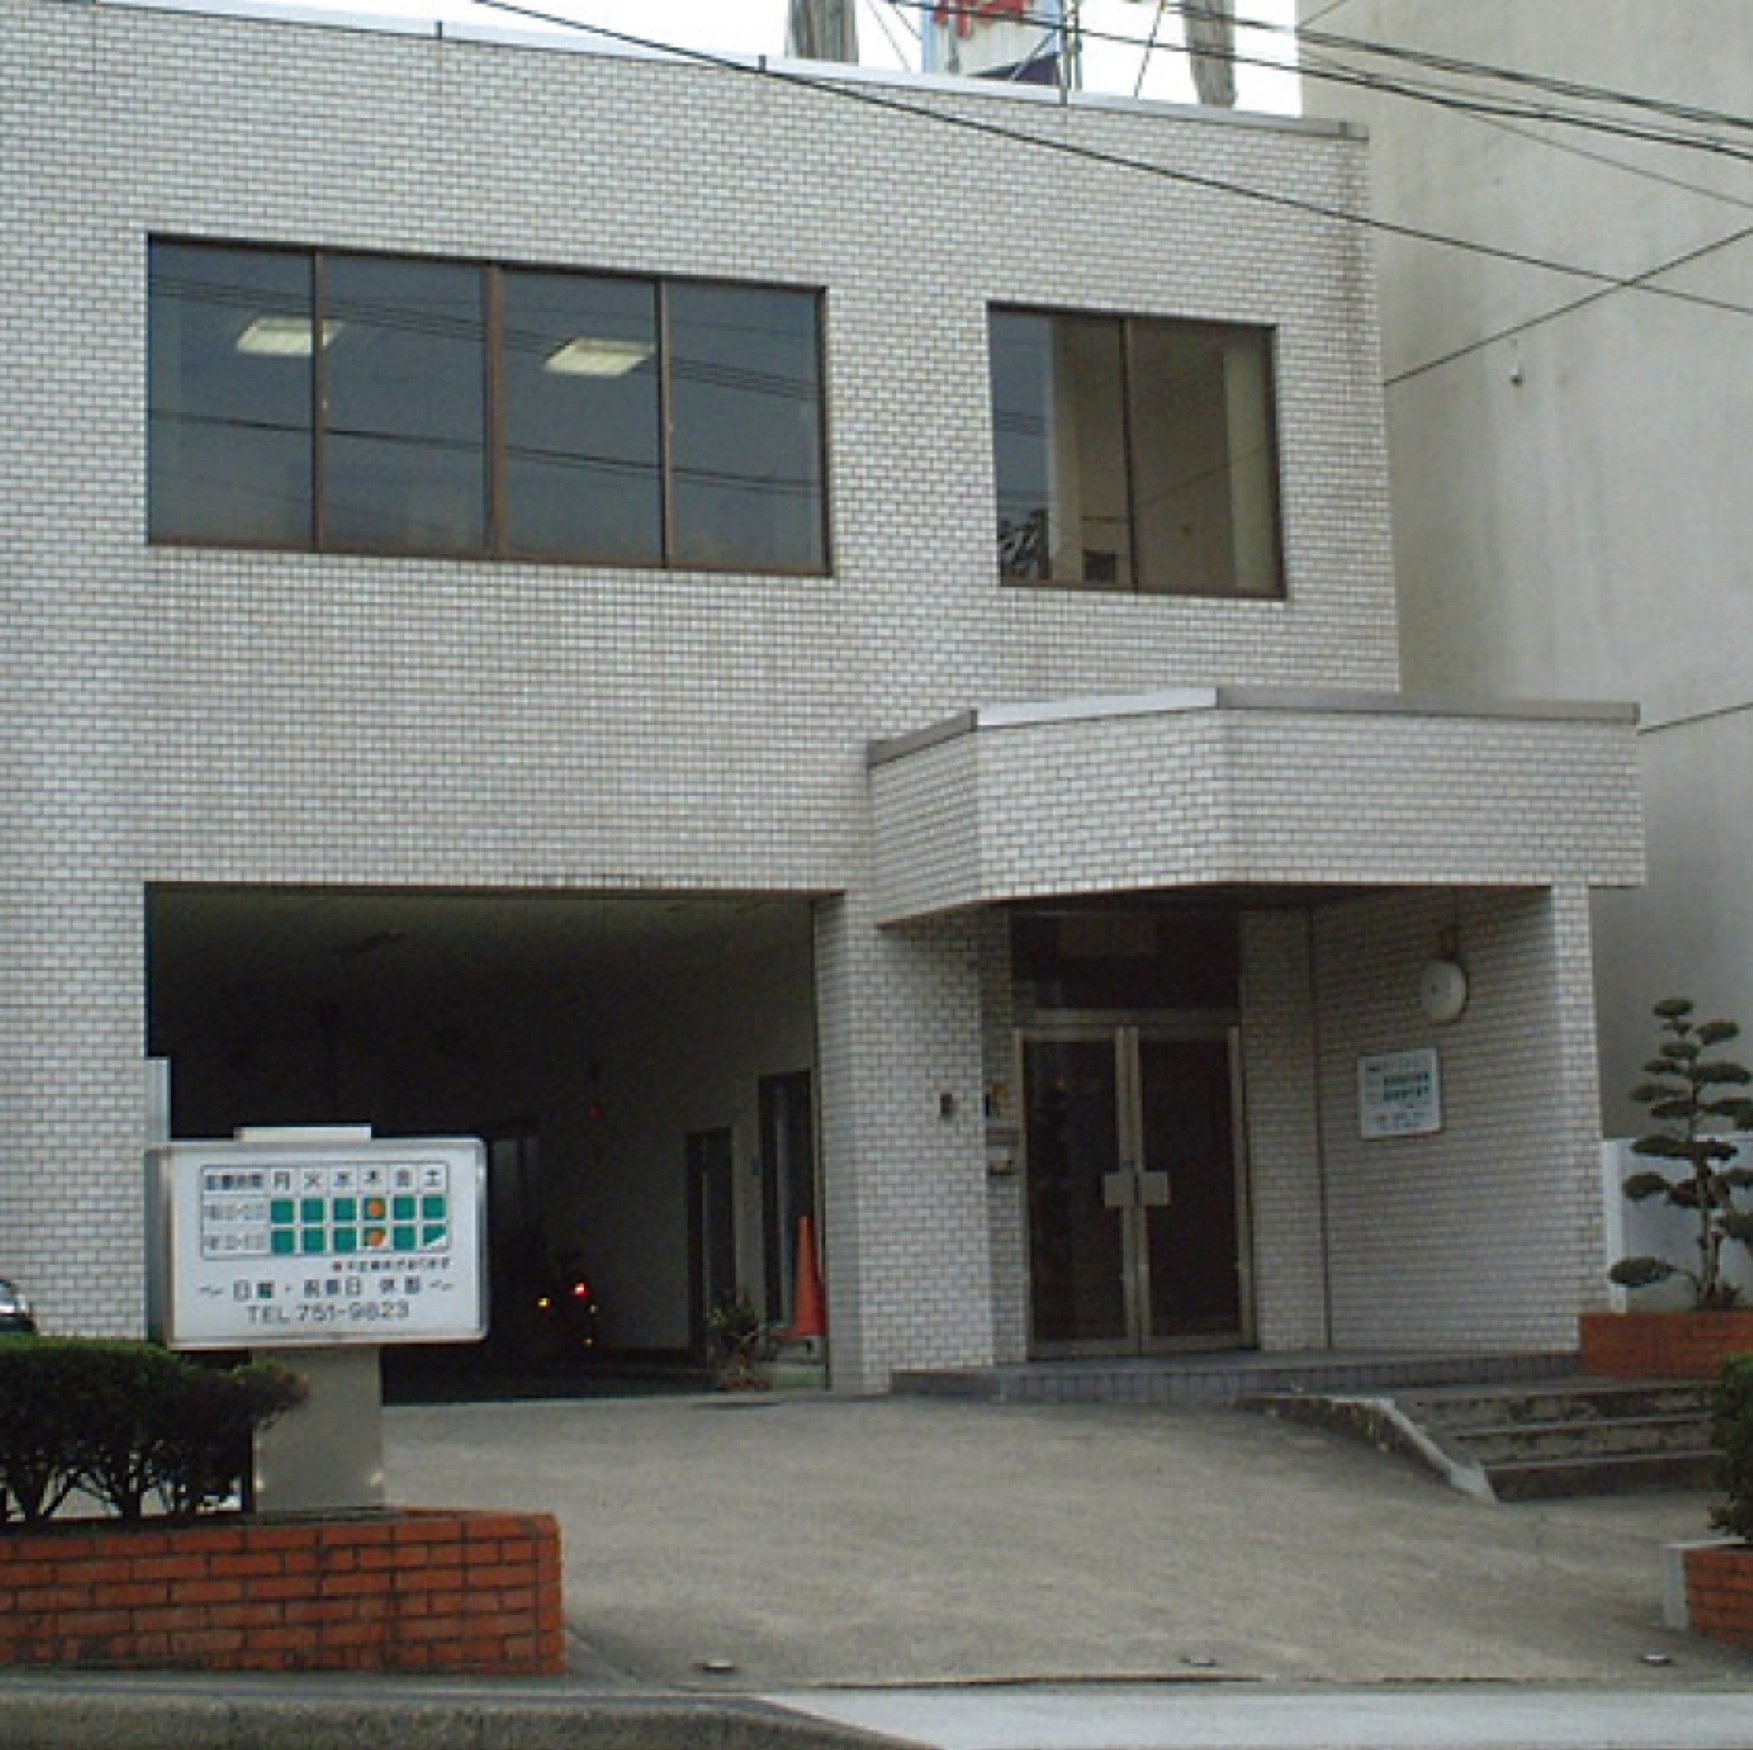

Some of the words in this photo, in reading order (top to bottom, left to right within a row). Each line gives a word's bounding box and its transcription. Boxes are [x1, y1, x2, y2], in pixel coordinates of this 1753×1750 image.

[274, 1171, 291, 1190] 月
[423, 1169, 440, 1187] 土
[246, 1305, 290, 1324] TEL
